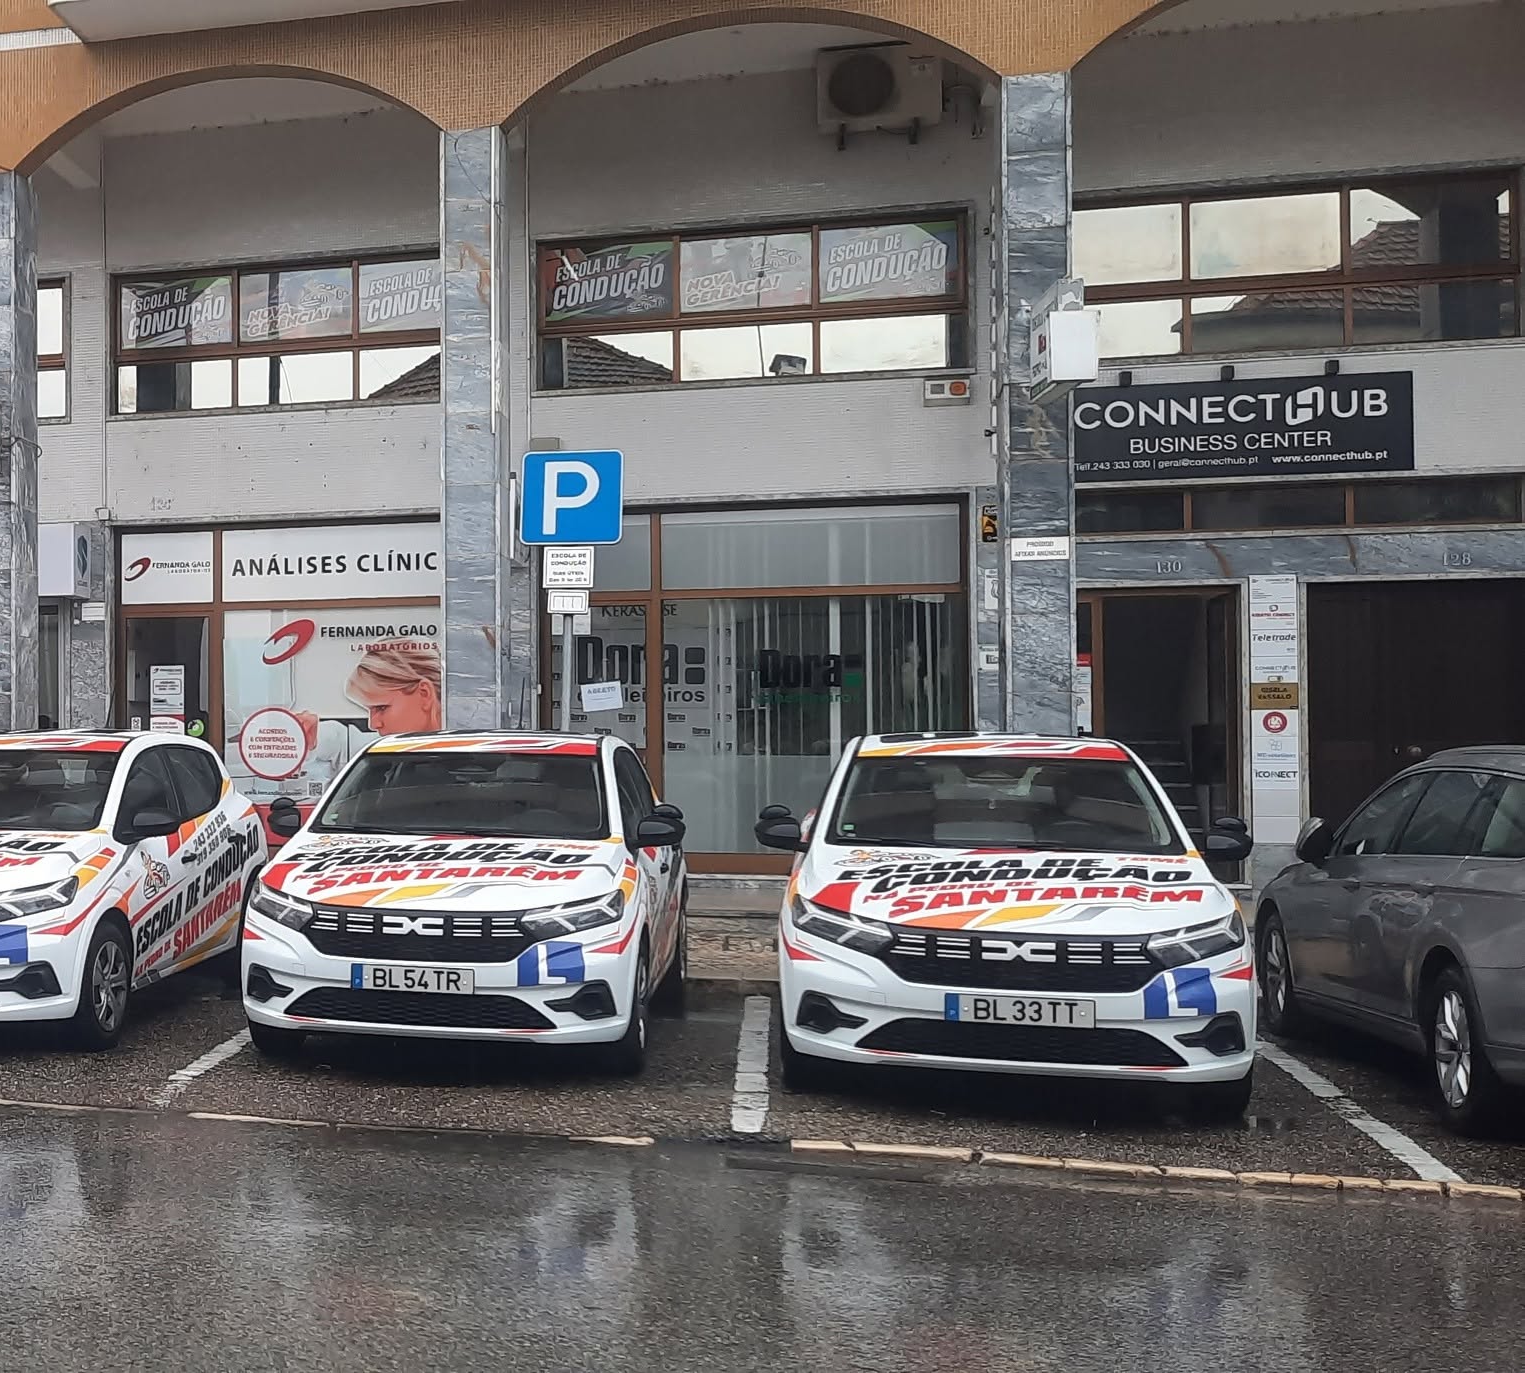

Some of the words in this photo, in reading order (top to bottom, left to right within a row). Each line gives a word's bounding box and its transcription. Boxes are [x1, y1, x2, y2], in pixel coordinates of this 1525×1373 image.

[829, 238, 879, 264] ESCOLA
[884, 233, 901, 252] DE
[555, 261, 601, 283] ESCOLA
[605, 253, 622, 271] DE
[826, 241, 947, 292] CONDUÇÃO
[369, 276, 414, 296] ESCOLA
[415, 267, 433, 286] DE
[552, 260, 665, 311] CONDUÇÃO
[685, 270, 734, 294] NOVA
[130, 291, 170, 314] ESCOLA
[174, 286, 189, 304] DE
[248, 303, 291, 325] NOVA
[128, 294, 226, 340] CONDUÇÃO
[1129, 434, 1238, 454] BUSINESS
[1244, 430, 1332, 450] CENTER
[1271, 450, 1389, 464] www.connecthub.pt
[542, 460, 600, 535] P
[152, 561, 190, 569] FERNANDA
[191, 560, 211, 568] GALO
[231, 554, 348, 577] ANÁLISES
[356, 549, 438, 573] CLÍNIC
[1155, 560, 1182, 574] 130
[1441, 552, 1472, 567] 128
[320, 625, 396, 638] FERNANDA
[398, 624, 438, 637] GALO
[282, 843, 455, 862] ESCOLA
[463, 842, 526, 853] DE
[302, 848, 595, 873] CONDUÇÃO
[306, 865, 585, 895] SANTARÉM
[835, 858, 1015, 881] ESCOLA
[1041, 858, 1105, 868] DE
[870, 865, 1193, 893] CONDUÇÃO
[888, 885, 1205, 919] SANTARÉM
[135, 891, 183, 960] ESCOLA
[185, 875, 202, 915] DE
[172, 876, 243, 961] SANTARÉM
[537, 944, 567, 985] L
[1164, 971, 1199, 1018] L
